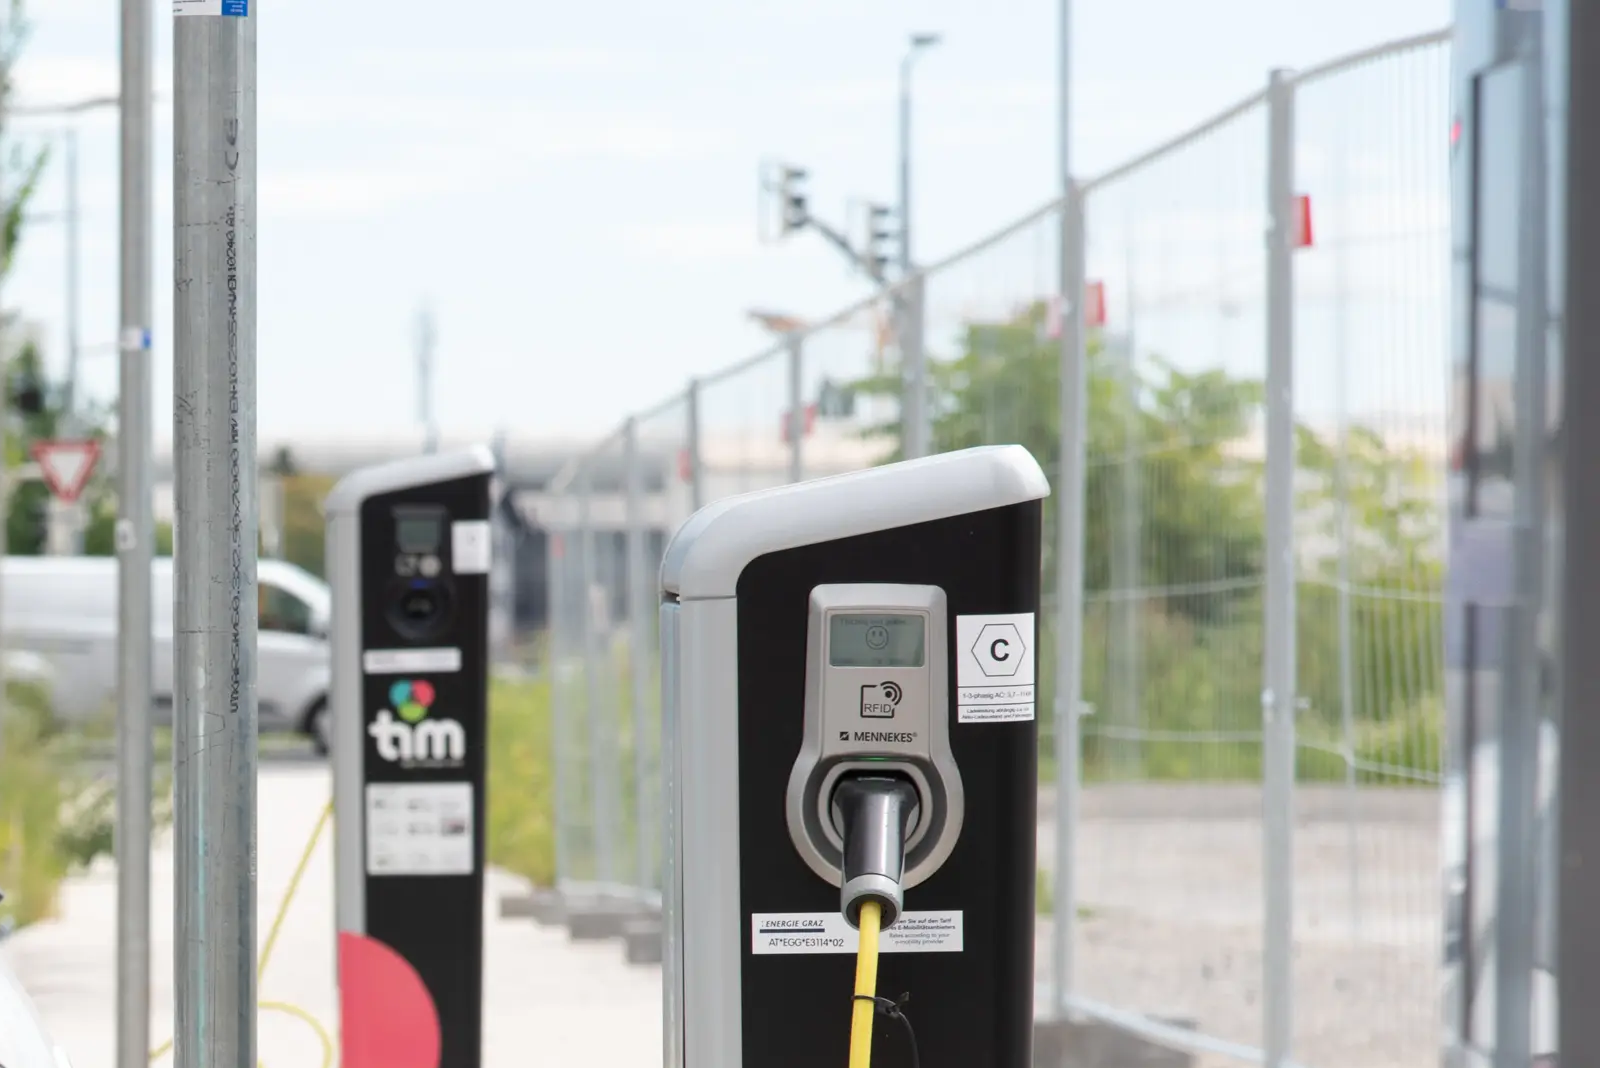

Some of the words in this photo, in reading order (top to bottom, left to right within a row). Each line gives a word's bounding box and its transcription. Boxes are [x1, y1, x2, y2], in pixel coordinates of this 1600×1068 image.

[990, 638, 1010, 662] C
[864, 703, 892, 713] RFID
[765, 920, 800, 928] ENERGIE
[801, 919, 824, 928] GRAZ
